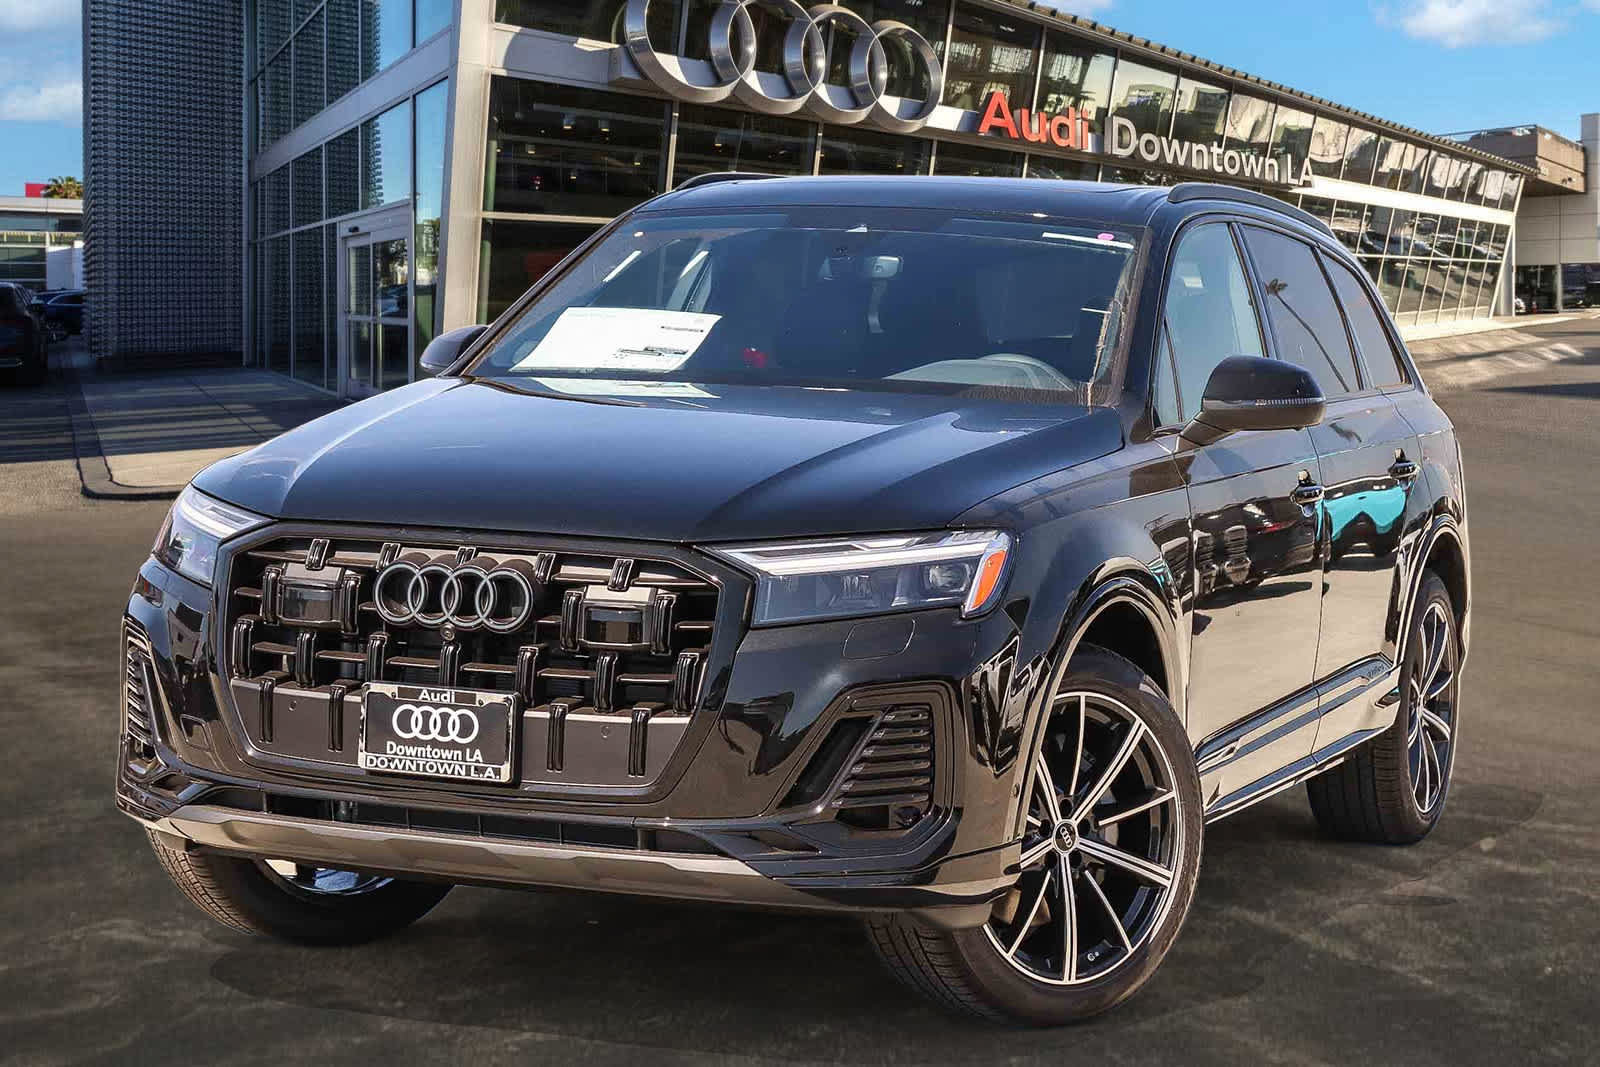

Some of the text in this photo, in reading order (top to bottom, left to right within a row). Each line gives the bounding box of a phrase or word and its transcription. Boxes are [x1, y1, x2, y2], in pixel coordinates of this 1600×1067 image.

[978, 91, 1316, 187] Audi Downtown LA
[418, 689, 456, 703] Audi
[386, 740, 483, 763] Downtown LA
[366, 756, 500, 780] DOWNTOWN L.A.
